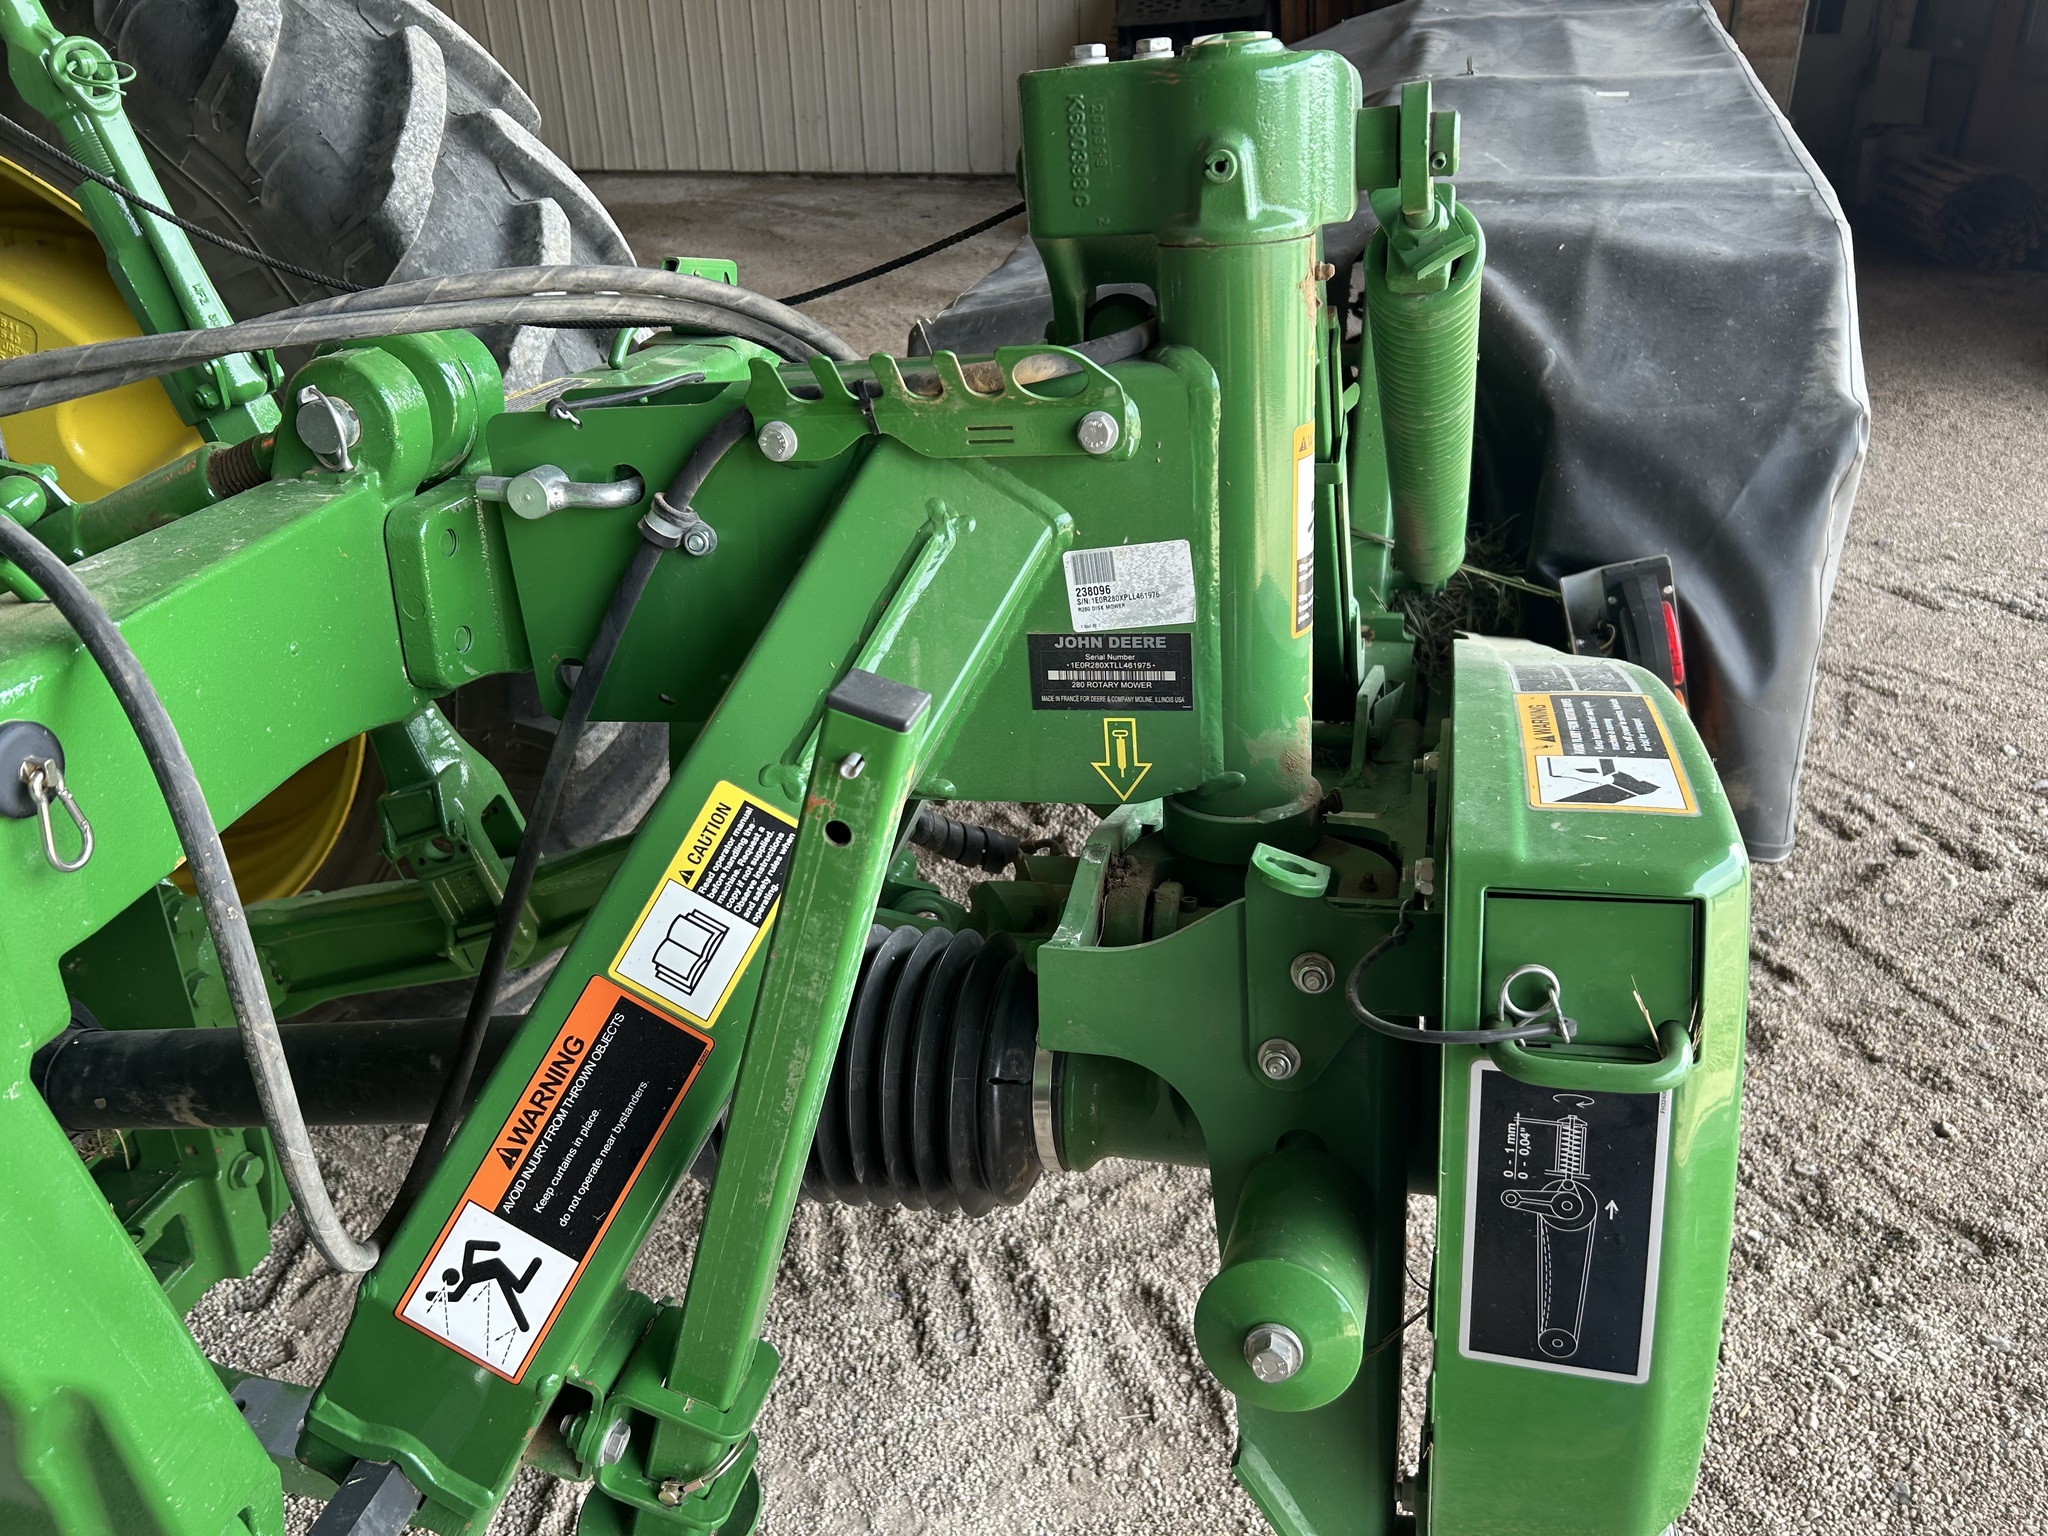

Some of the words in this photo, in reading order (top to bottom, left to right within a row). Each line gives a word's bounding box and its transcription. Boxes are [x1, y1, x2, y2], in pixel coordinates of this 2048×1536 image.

[1076, 585, 1111, 598] 238096
[1054, 636, 1102, 648] JOHN
[1109, 636, 1166, 648] DEERE
[1528, 704, 1552, 736] WARNING
[687, 802, 732, 866] CAUTION
[699, 872, 716, 894] Read
[713, 836, 736, 872] operator
[732, 806, 754, 838] manual
[750, 830, 776, 867] supplied.
[707, 872, 727, 900] before
[722, 838, 748, 874] handling
[743, 823, 756, 838] the
[716, 868, 742, 904] machine.
[737, 832, 762, 868] Request
[734, 880, 758, 914] Observe
[753, 832, 785, 880] instructions
[742, 865, 754, 880] not
[743, 902, 756, 919] and
[752, 876, 772, 901] safety
[767, 855, 783, 877] rules
[779, 832, 796, 856] when
[726, 888, 742, 909] copy
[739, 880, 746, 889] if
[752, 883, 780, 923] operating.
[506, 1035, 585, 1146] WARNING
[502, 1180, 528, 1214] AVOID
[521, 1139, 548, 1182] INJURY
[544, 1107, 570, 1143] FROM
[563, 1059, 597, 1111] THROWN
[591, 1012, 626, 1063] OBJECTS
[1507, 1123, 1516, 1145] mm
[1519, 1127, 1532, 1156] 0,04"
[533, 1184, 556, 1214] Keep
[550, 1147, 577, 1186] curtains
[573, 1136, 583, 1149] in
[579, 1108, 602, 1138] place.
[558, 1211, 570, 1228] do
[567, 1193, 582, 1215] not
[577, 1158, 604, 1197] operate
[600, 1134, 616, 1159] near
[611, 1080, 650, 1135] bystanders.
[1503, 1170, 1514, 1178] 0
[1518, 1172, 1528, 1180] 0
